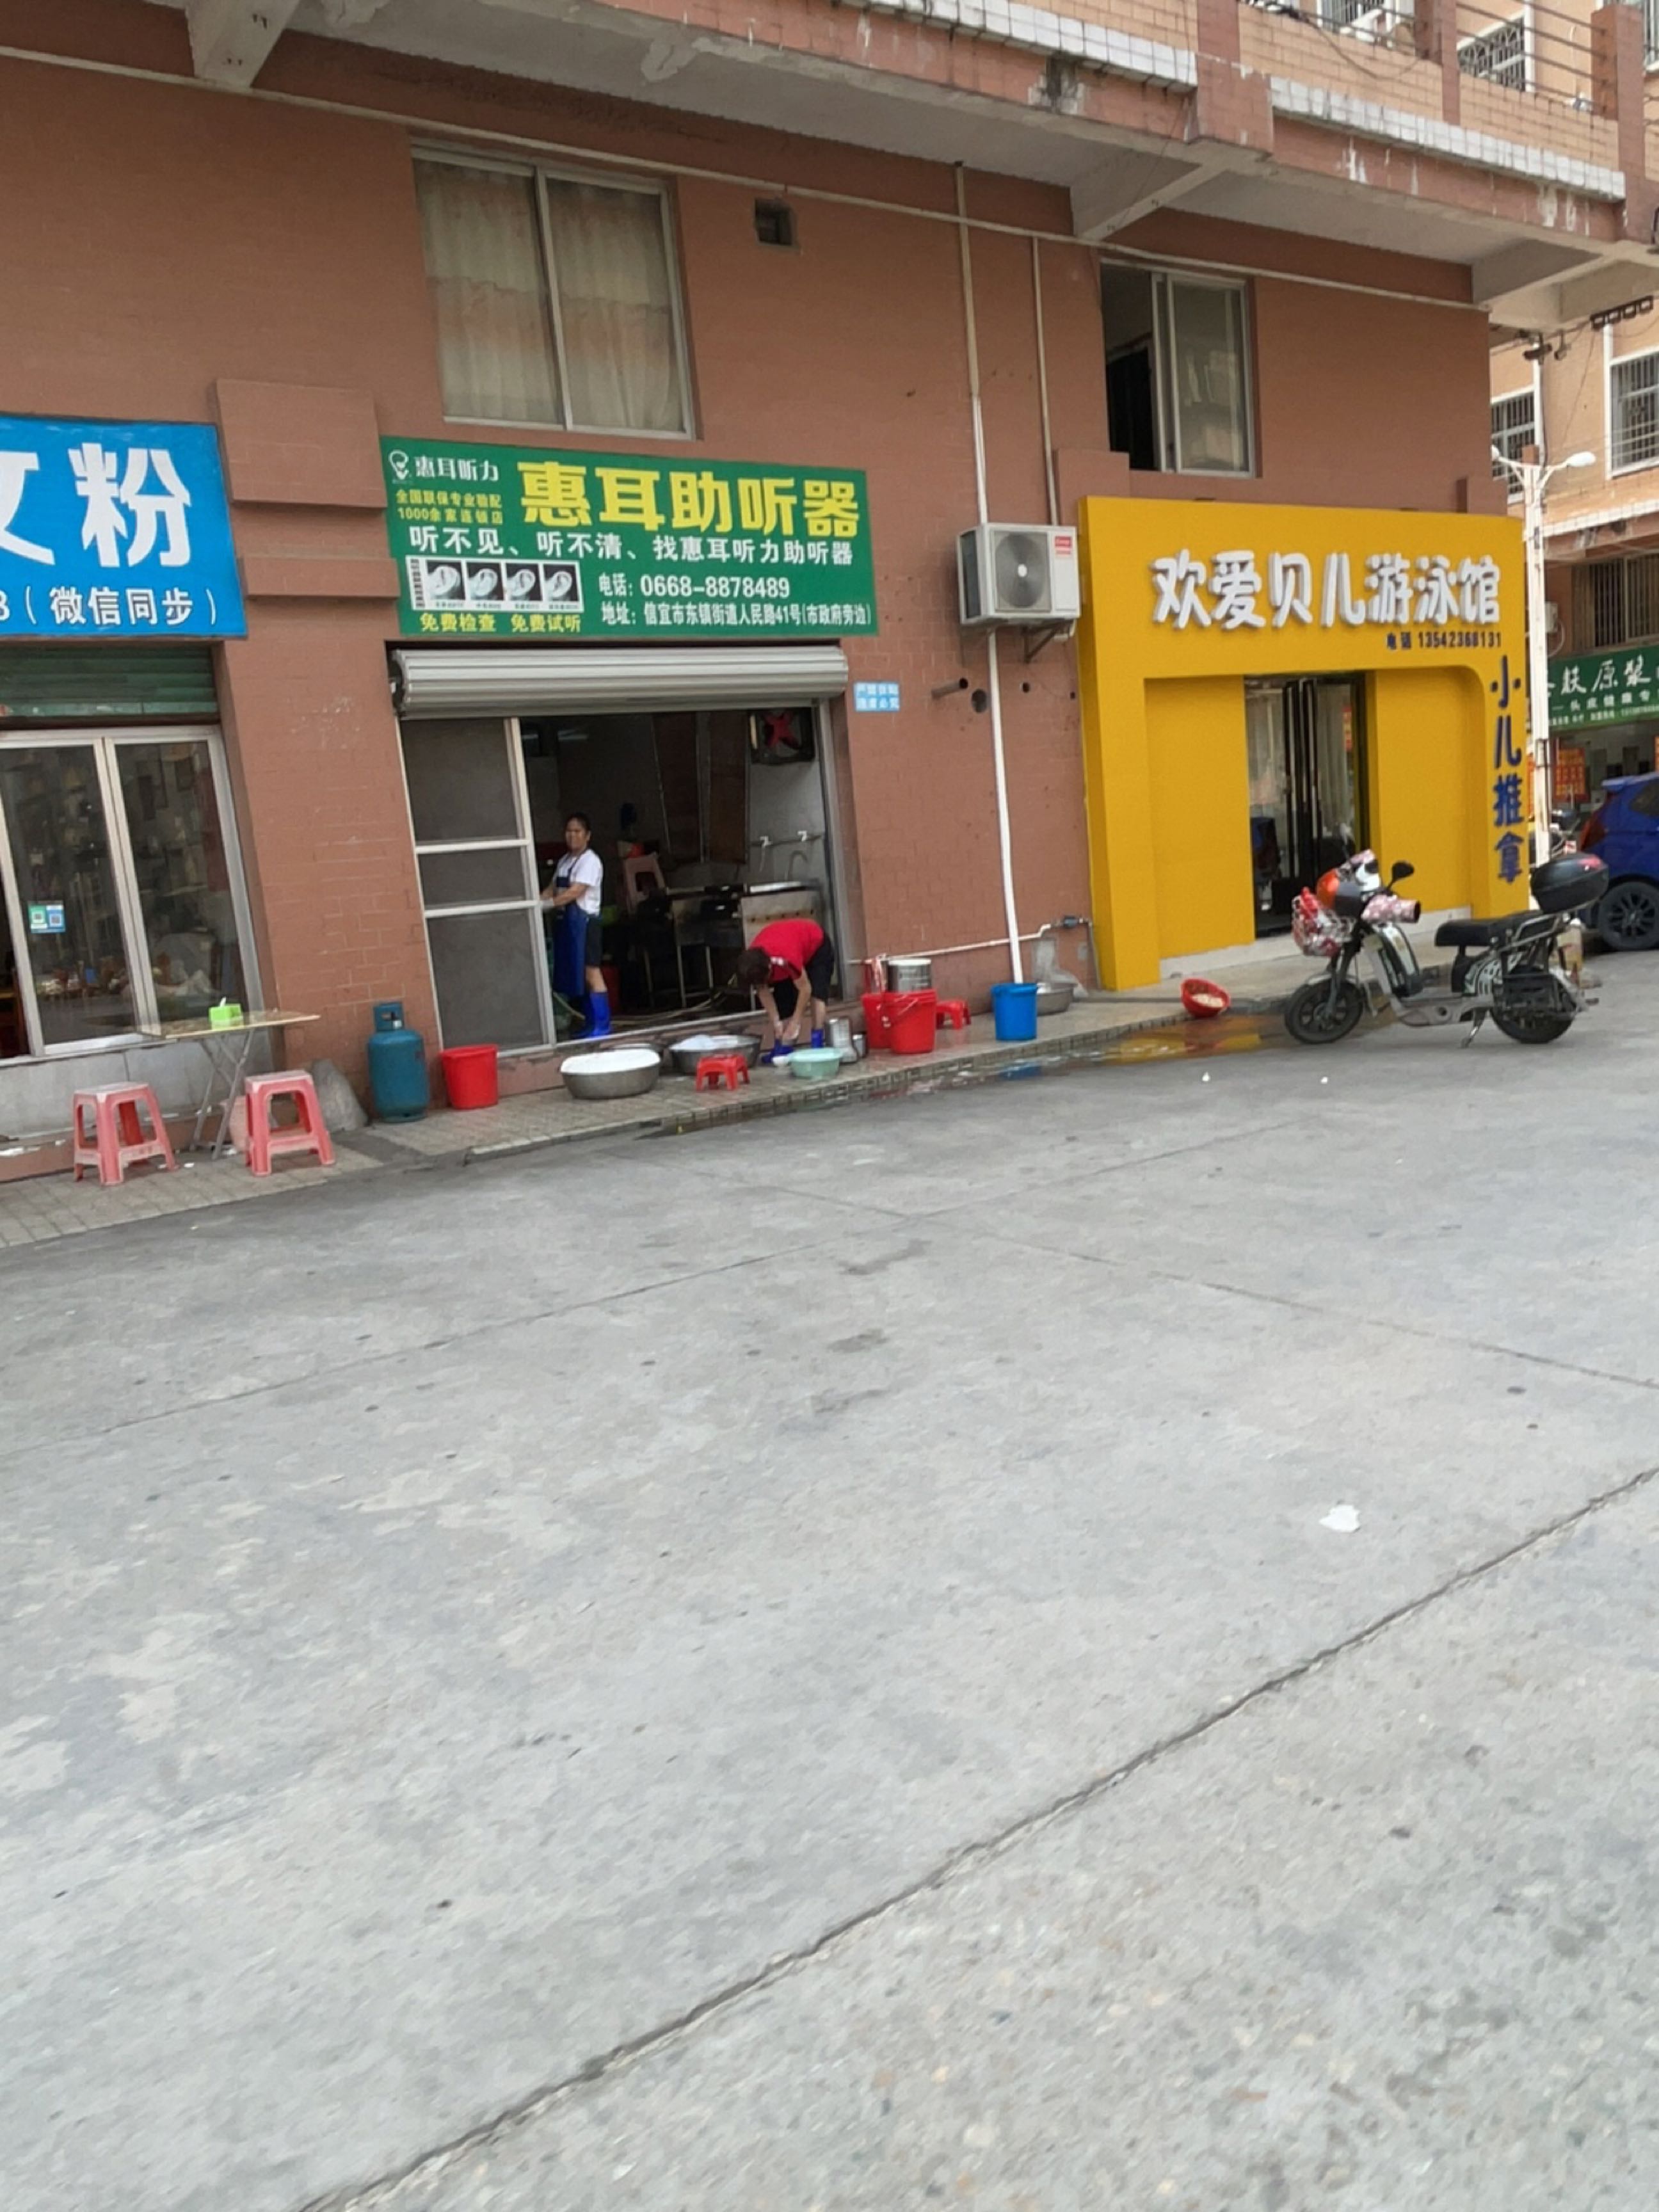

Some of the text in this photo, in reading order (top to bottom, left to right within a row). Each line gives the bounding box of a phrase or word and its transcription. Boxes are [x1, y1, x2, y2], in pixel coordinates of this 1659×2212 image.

[415, 455, 499, 481] 惠耳听力
[518, 461, 858, 538] 惠耳助听器
[641, 574, 790, 598] 0668-8878489
[1151, 549, 1500, 629] 欢爱贝儿游泳馆
[420, 613, 581, 633] 免费检查 免费试听
[1490, 655, 1524, 884] 小儿推拿
